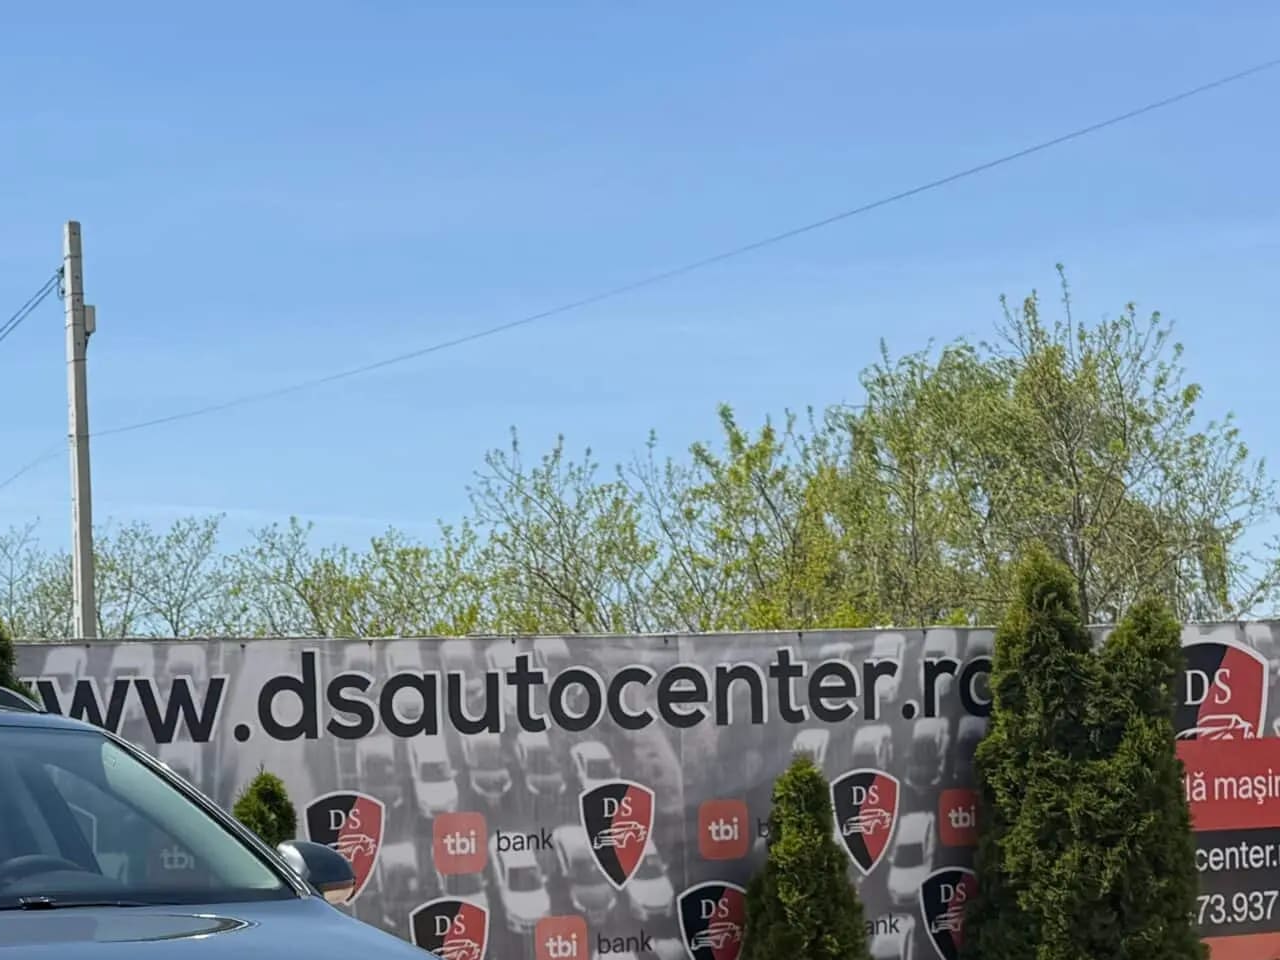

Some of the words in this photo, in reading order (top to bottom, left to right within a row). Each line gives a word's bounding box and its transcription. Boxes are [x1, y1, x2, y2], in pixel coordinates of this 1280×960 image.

[22, 650, 994, 744] ww.dsautocenter.ro
[1184, 669, 1231, 705] DS
[852, 786, 879, 806] DS
[1182, 771, 1207, 801] lă
[329, 809, 361, 830] DS
[603, 797, 633, 818] DS
[948, 806, 976, 828] tbi
[708, 817, 739, 841] tbi
[443, 831, 477, 855] tbi
[496, 828, 554, 852] bank
[940, 883, 966, 903] DS
[701, 899, 729, 919] DS
[1186, 890, 1279, 926] 73.937
[435, 914, 466, 936] DS
[864, 912, 900, 936] ank
[545, 934, 577, 958] tbi
[597, 929, 653, 954] bank
